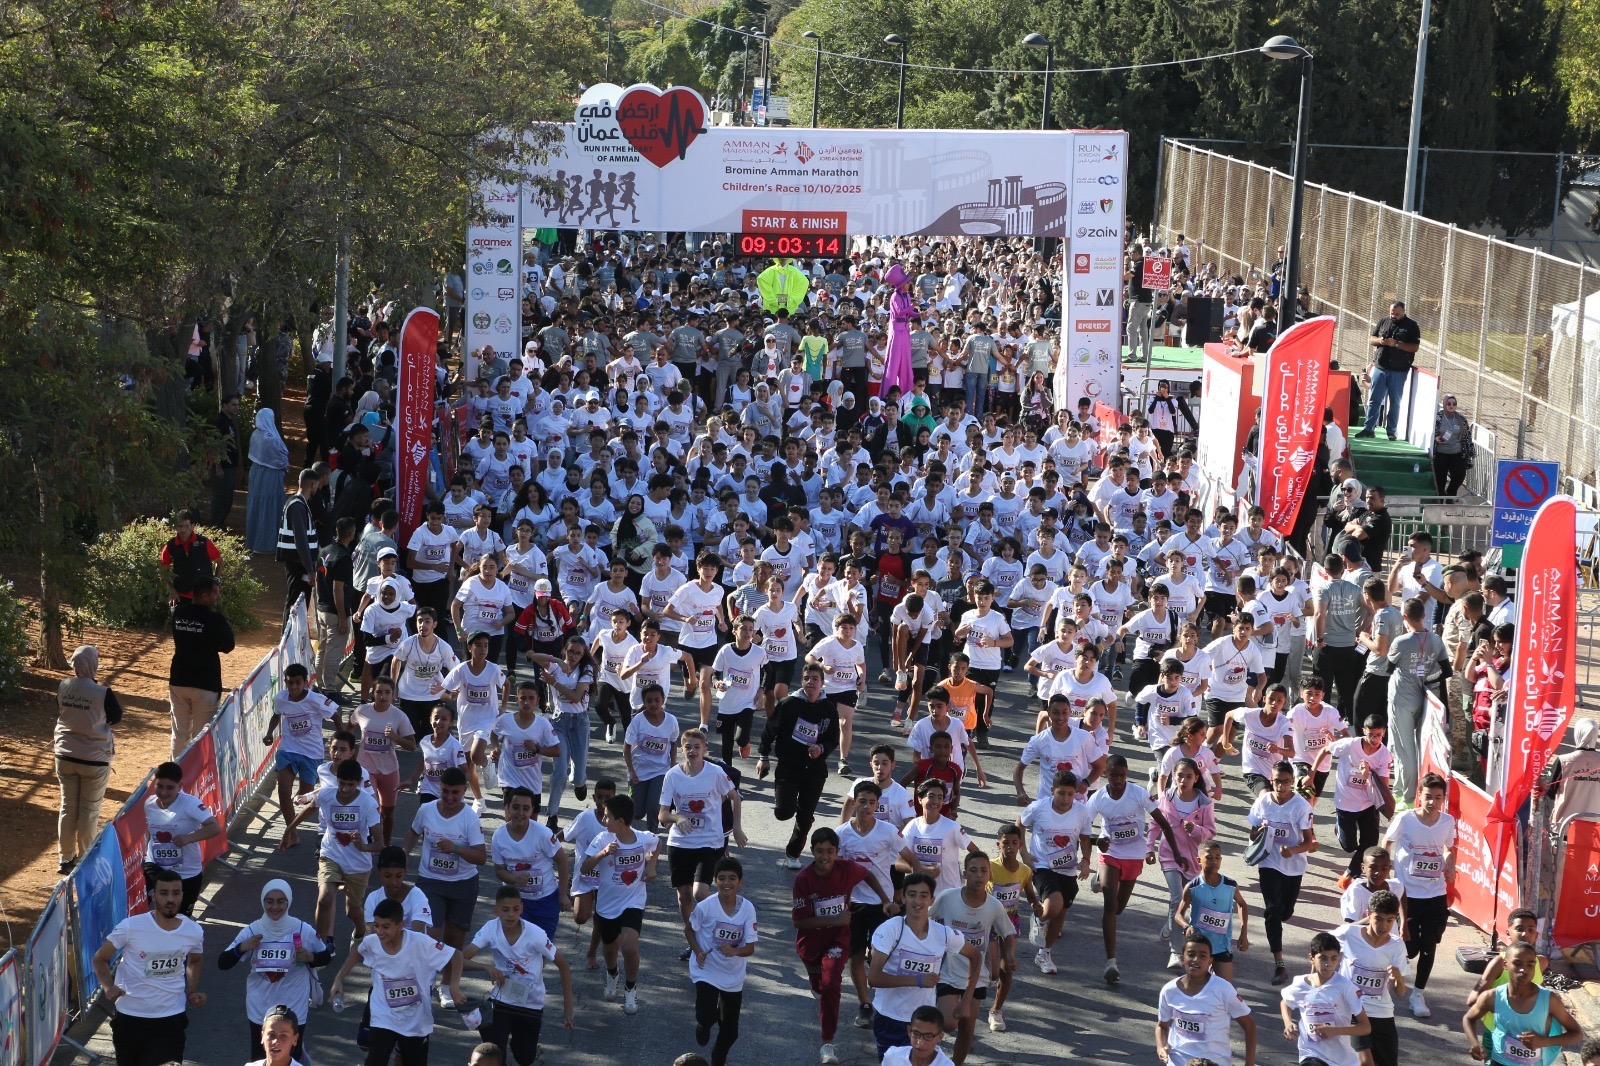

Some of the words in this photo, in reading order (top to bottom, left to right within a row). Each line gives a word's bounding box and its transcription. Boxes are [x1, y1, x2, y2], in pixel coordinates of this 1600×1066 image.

[723, 140, 770, 148] AMMAN
[1078, 144, 1101, 152] RUN
[725, 166, 767, 175] Bromine
[770, 167, 808, 176] Amman
[811, 168, 859, 177] Marathon
[722, 182, 772, 192] Children's
[776, 184, 800, 193] Race
[803, 184, 862, 193] 10/10/2025
[751, 217, 786, 228] START
[790, 218, 798, 228] &
[802, 218, 838, 228] FINISH
[473, 238, 512, 247] aramex
[1077, 322, 1109, 330] ENERGY
[1279, 362, 1295, 412] عمان
[1307, 360, 1320, 415] AMMAN
[1501, 511, 1525, 523] الوقوف
[1494, 530, 1516, 541] الخاصة
[1529, 574, 1542, 651] عمان
[1550, 568, 1563, 652] AMMAN
[1146, 632, 1164, 640] 9728
[1181, 676, 1195, 684] 527
[469, 690, 488, 698] 9610
[797, 725, 818, 738] 9573
[367, 736, 387, 745] 9581
[645, 740, 664, 750] 9794
[1307, 737, 1327, 747] 5536
[334, 812, 356, 822] 9529
[1114, 828, 1136, 839] 9686
[156, 848, 178, 858] 9593
[916, 844, 938, 855] 9560
[432, 858, 455, 869] 9592
[618, 854, 641, 865] 9590
[1052, 853, 1073, 867] 9625
[1416, 861, 1439, 872] 9745
[996, 890, 1018, 901] 9672
[820, 904, 843, 916] 9738
[1203, 914, 1226, 928] 9683
[719, 929, 743, 940] 9761
[261, 949, 287, 959] 9619
[151, 958, 178, 970] 5743
[904, 960, 931, 974] 9732
[1356, 975, 1381, 988] 9718
[389, 986, 415, 999] 9758
[1177, 1017, 1200, 1032] 9735
[1509, 1045, 1537, 1059] 9685
